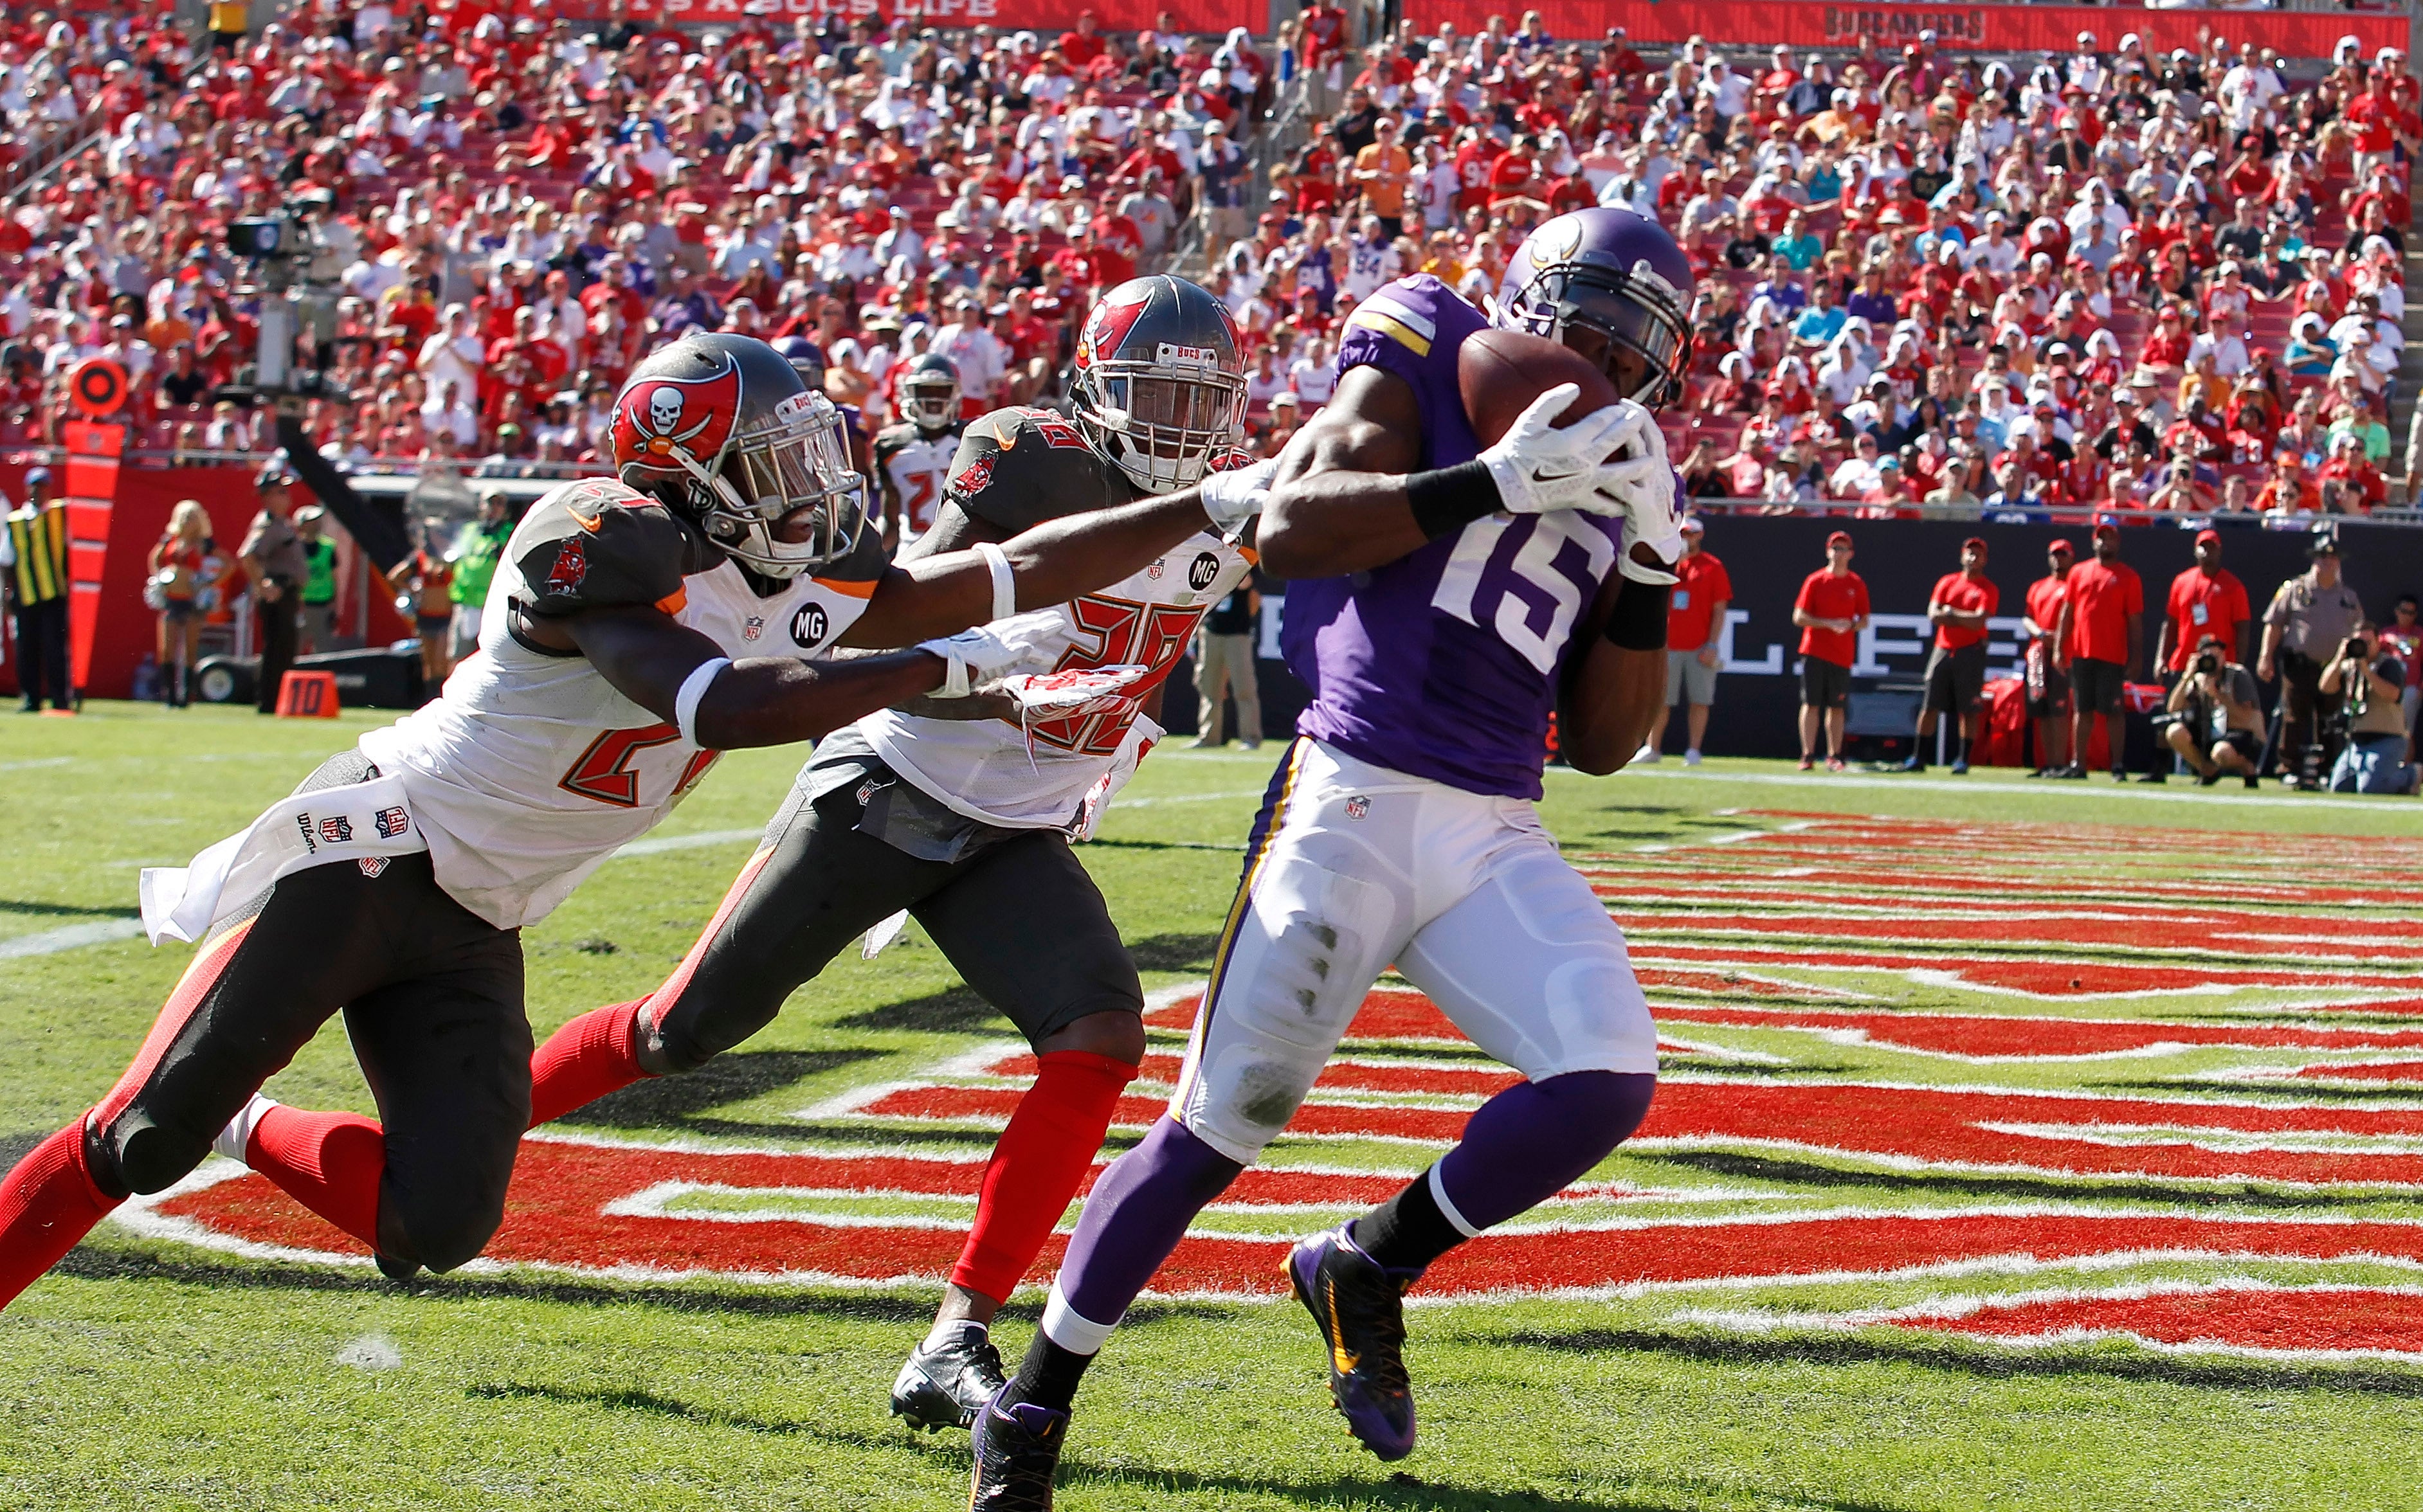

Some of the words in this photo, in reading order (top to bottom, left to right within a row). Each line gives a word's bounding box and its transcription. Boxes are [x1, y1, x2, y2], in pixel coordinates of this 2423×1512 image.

[893, 0, 997, 16] LIFE
[1826, 8, 1986, 42] BUCCANEERS
[903, 468, 949, 534] 2
[1148, 566, 1163, 577] NFL
[1192, 559, 1217, 583] MG
[1430, 510, 1616, 675] 15
[745, 626, 761, 640] NFL
[795, 611, 824, 640] MG
[1718, 608, 2028, 681] LFE
[291, 680, 324, 714] 10
[558, 721, 720, 809] 2
[387, 808, 406, 835] NFL
[1347, 803, 1365, 818] NFL
[297, 812, 317, 854] Wilson
[322, 819, 341, 842] NFL
[361, 857, 381, 874] NFL
